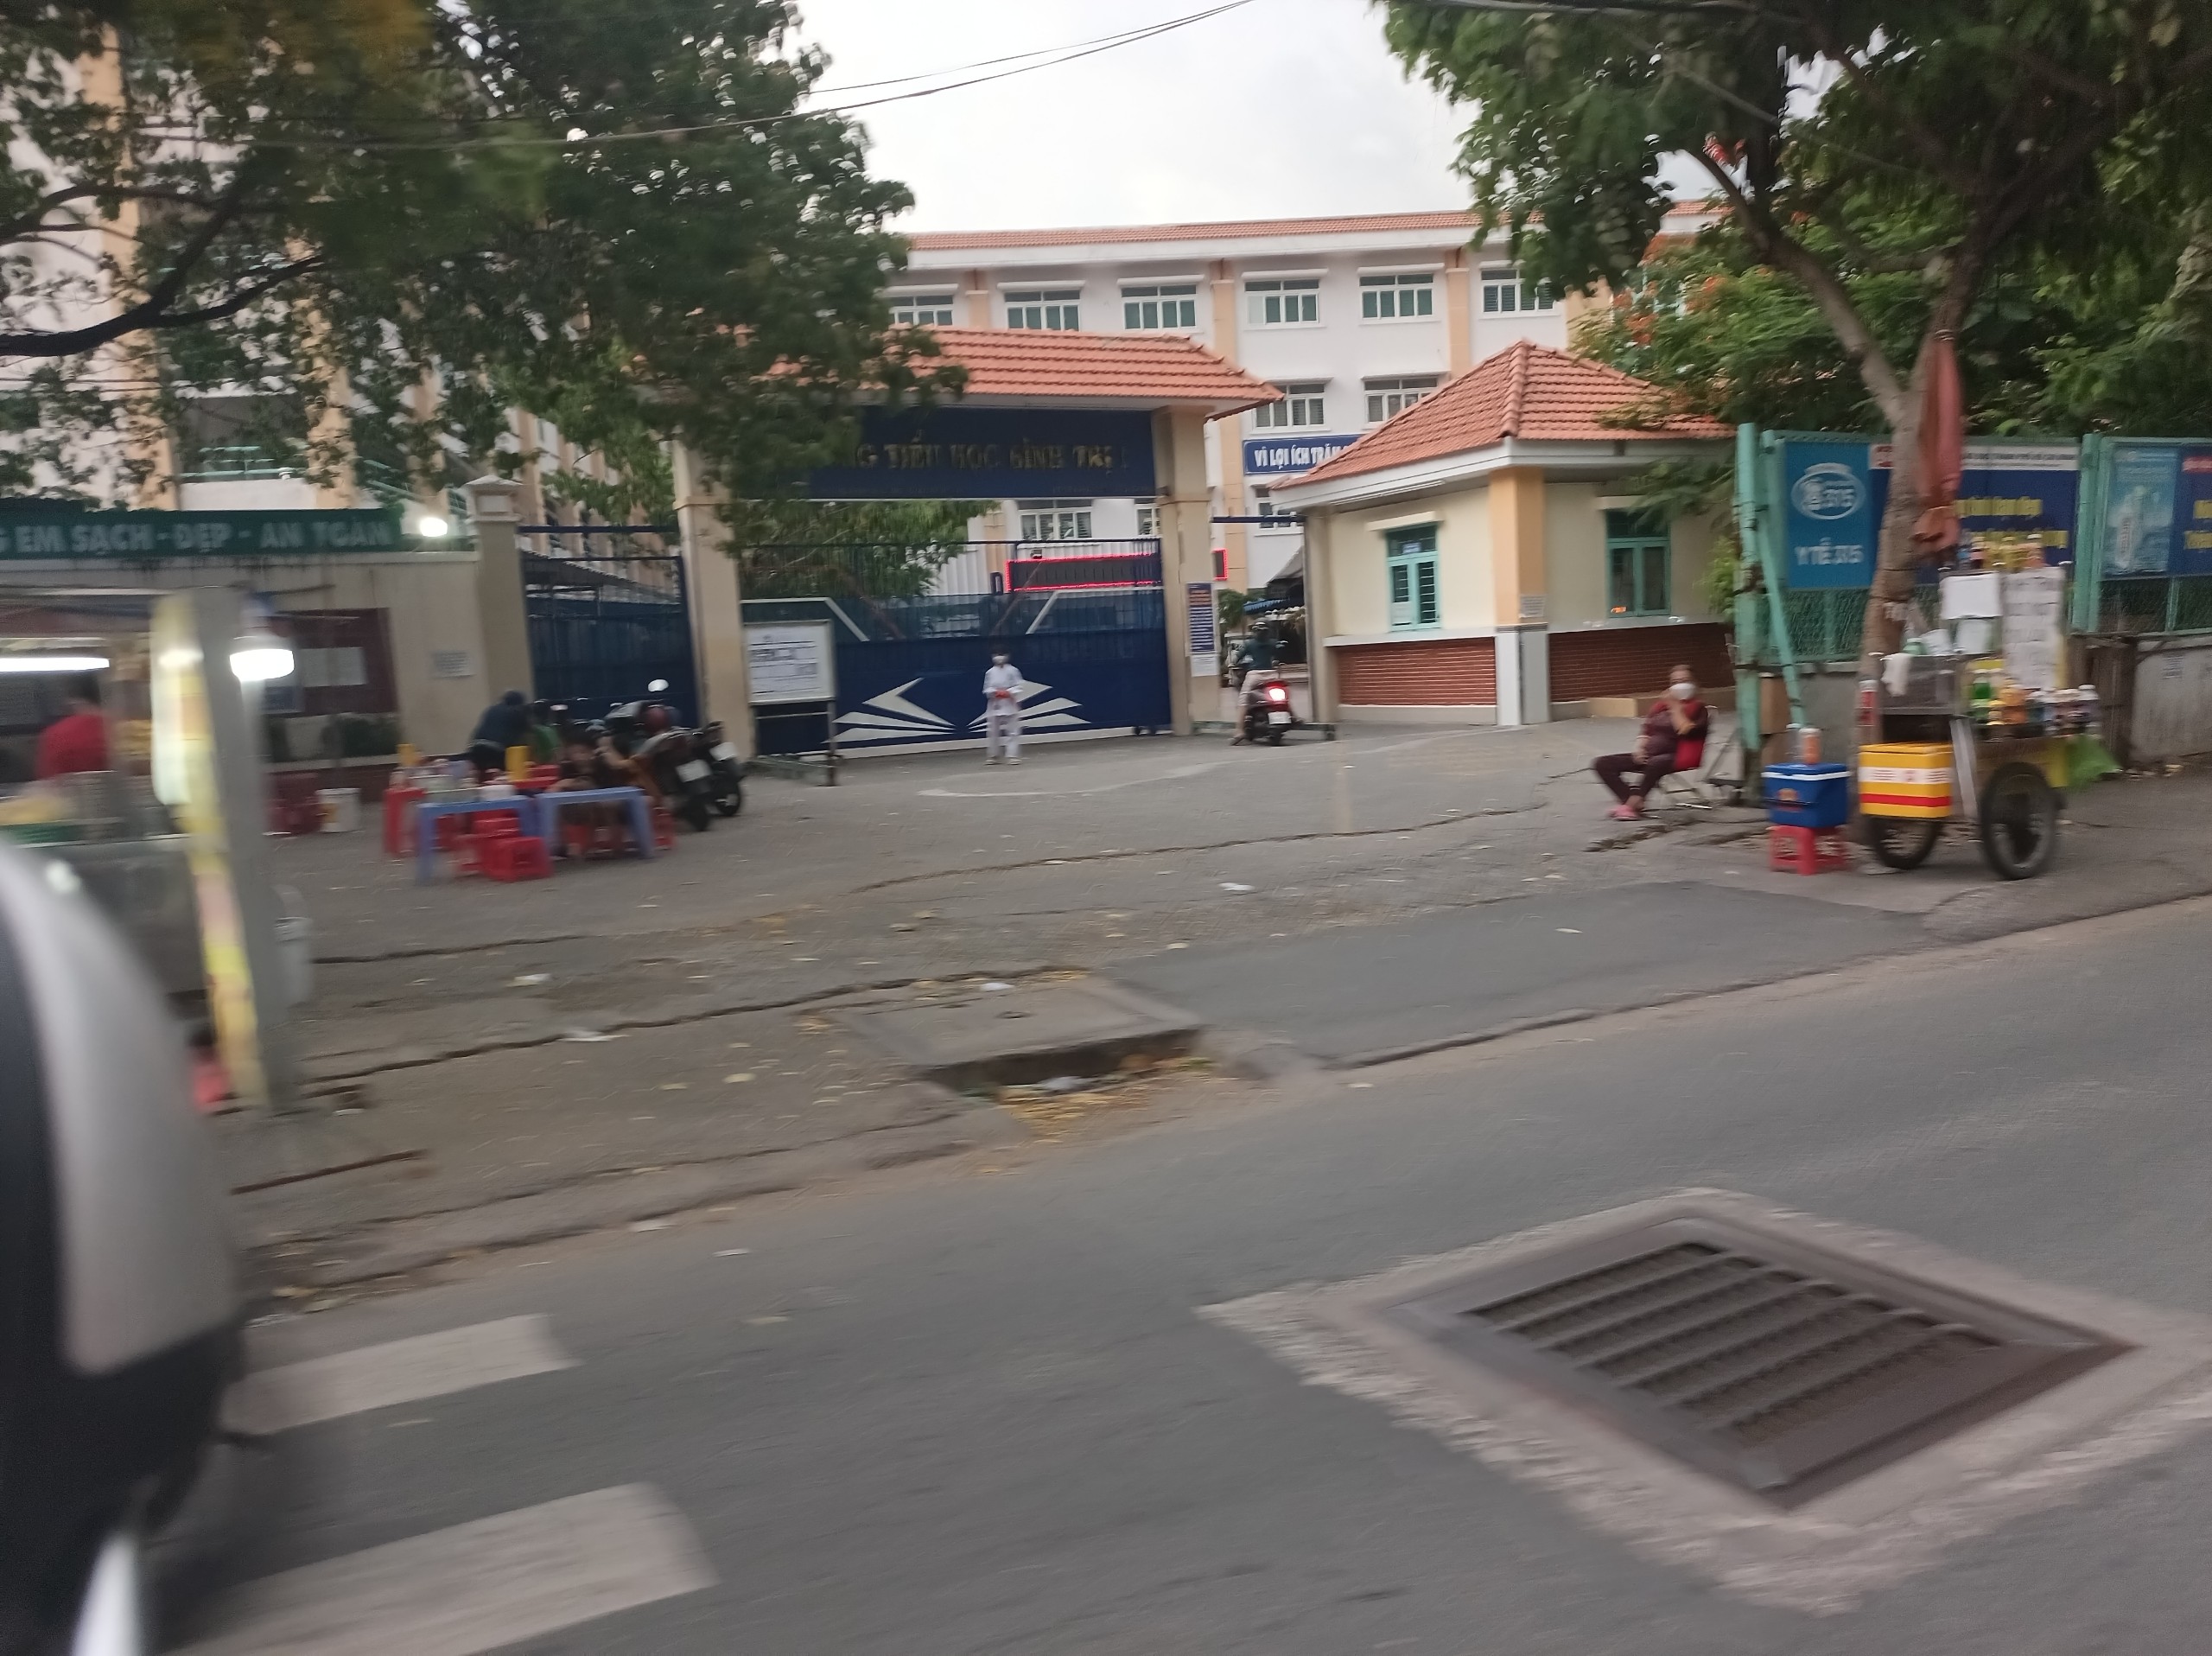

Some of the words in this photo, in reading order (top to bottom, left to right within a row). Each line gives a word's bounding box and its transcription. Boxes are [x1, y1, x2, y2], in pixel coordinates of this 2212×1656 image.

[15, 525, 67, 553] EM
[70, 524, 153, 556] SẠCH
[259, 522, 303, 547] AN
